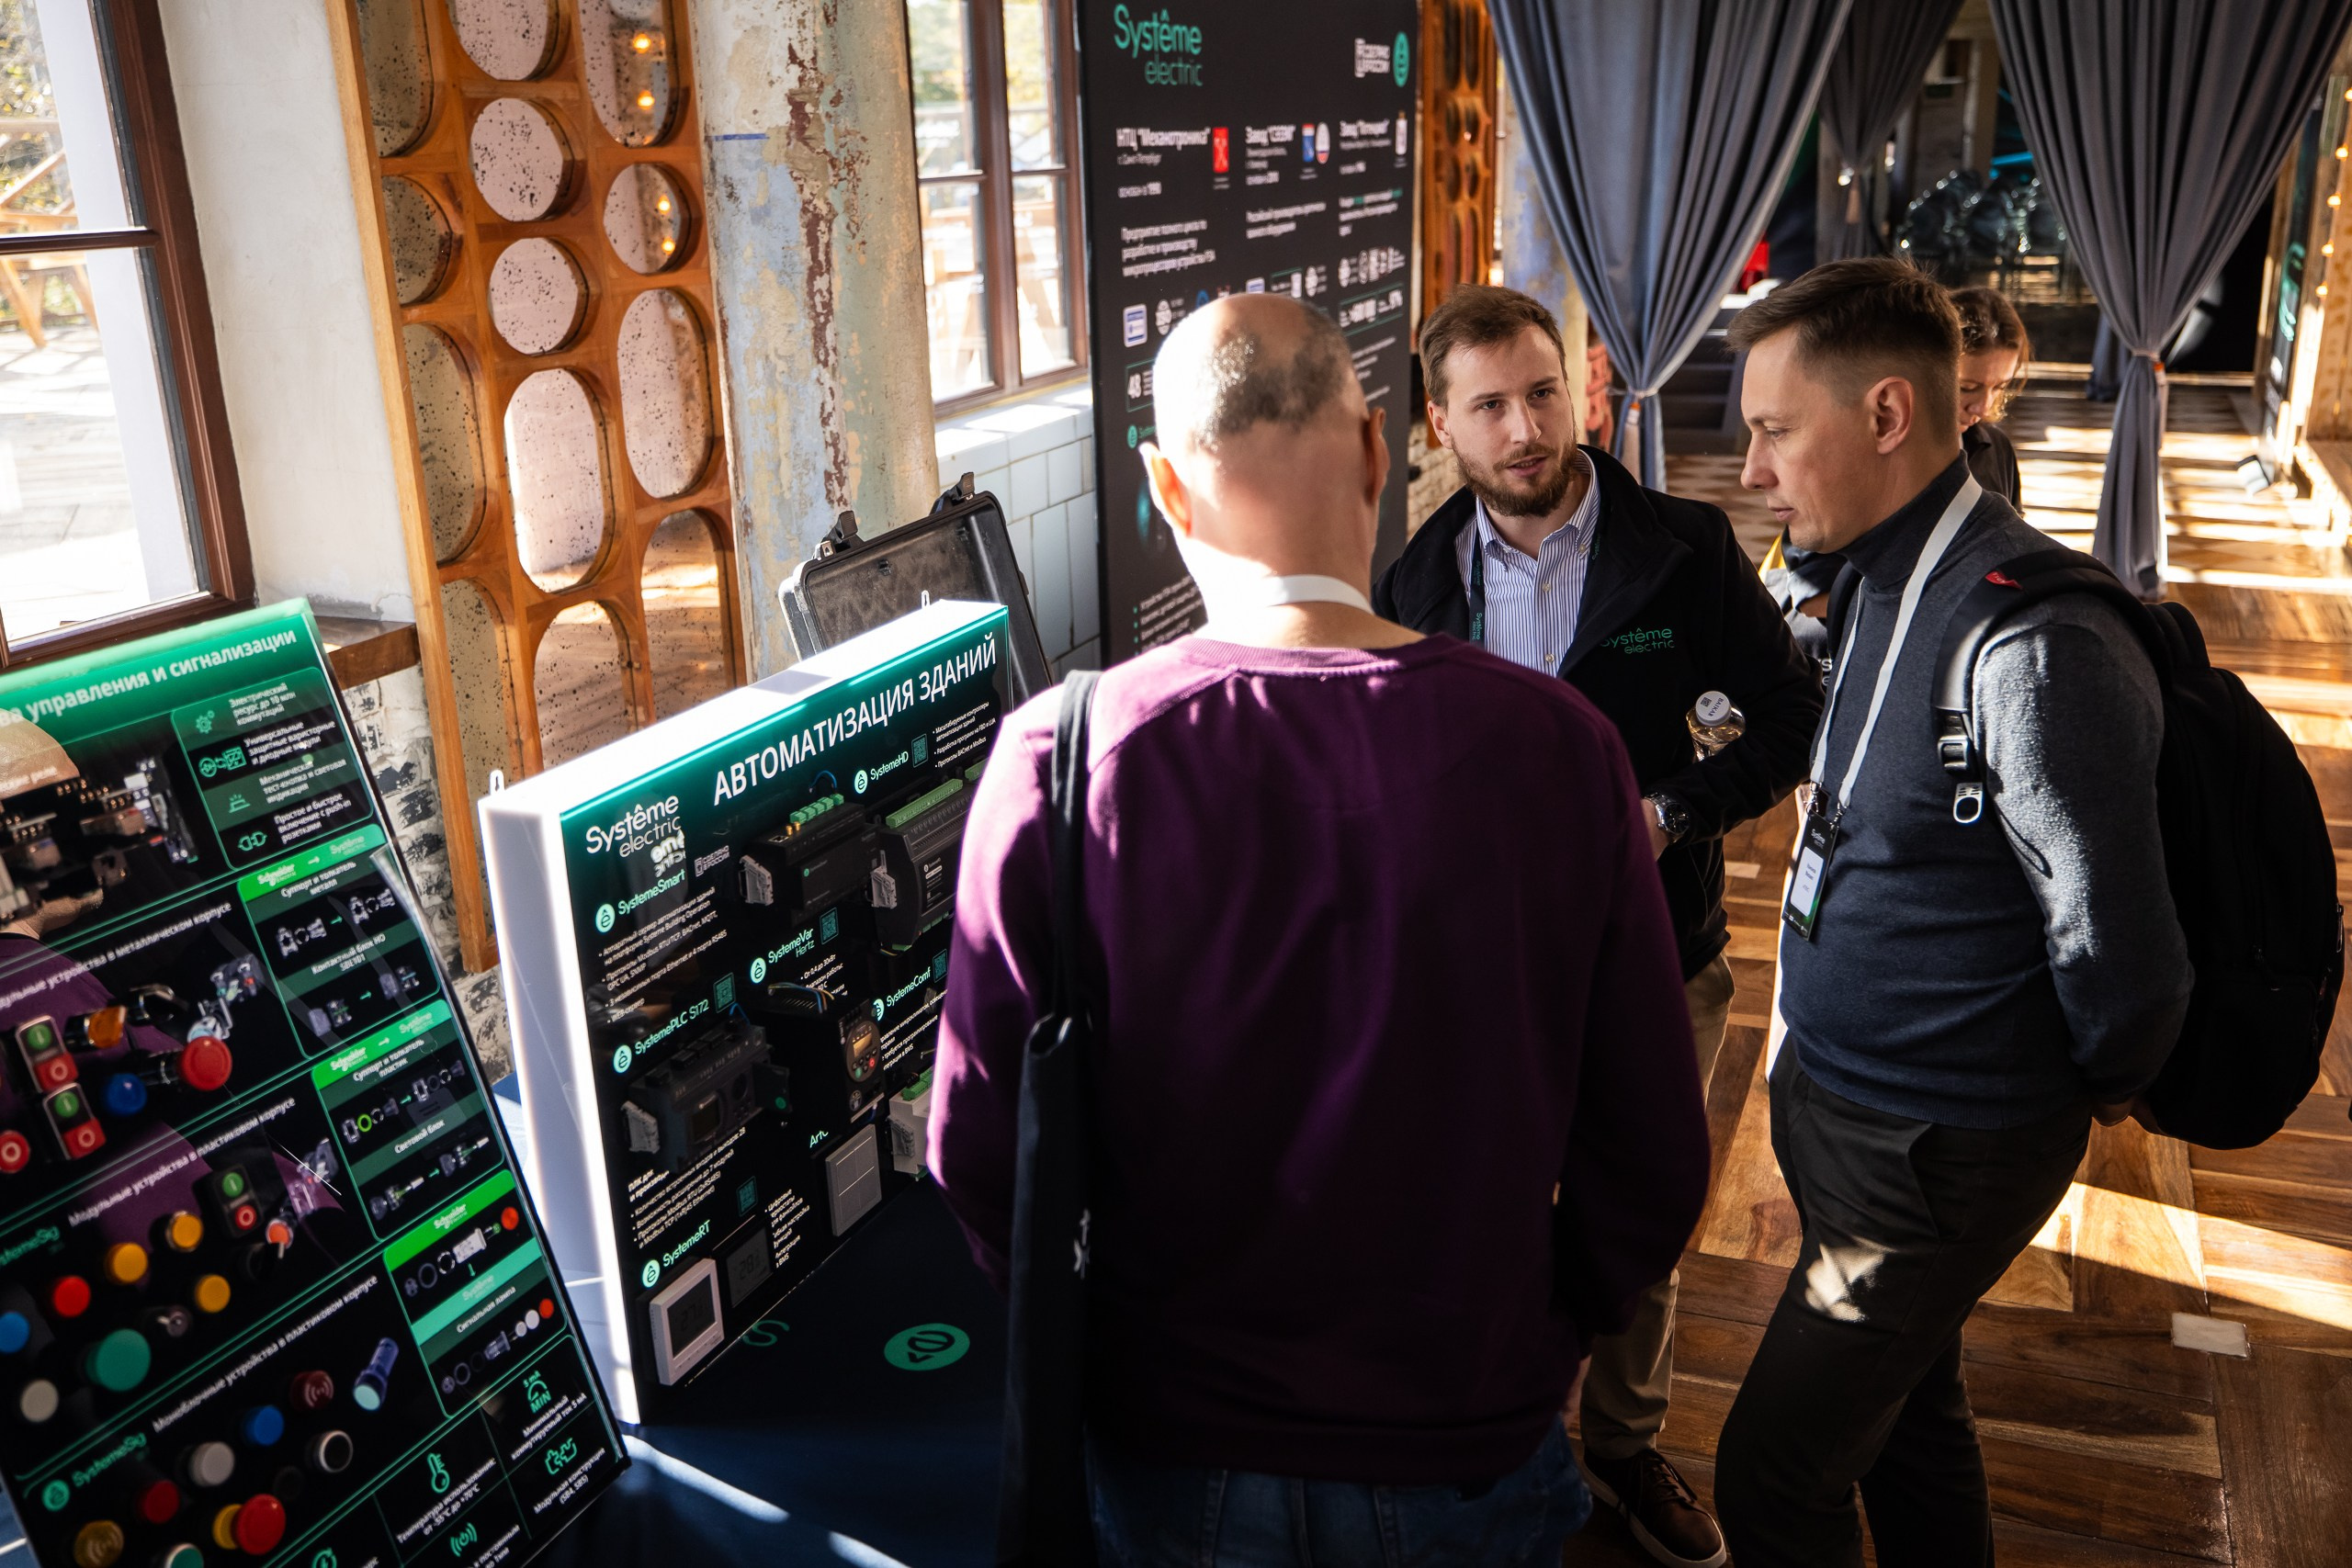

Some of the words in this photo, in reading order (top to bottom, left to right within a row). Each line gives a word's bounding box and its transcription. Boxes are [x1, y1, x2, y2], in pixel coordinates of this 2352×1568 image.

[1114, 4, 1203, 58] Systême
[1145, 58, 1203, 86] electric
[1624, 639, 1675, 654] electric
[27, 671, 149, 723] управления
[151, 666, 167, 682] и
[169, 630, 296, 676] сигнализации
[229, 682, 288, 708] Электрический
[232, 703, 259, 718] ресурс
[259, 699, 270, 710] до
[269, 694, 280, 704] 10
[278, 692, 296, 702] млн
[236, 703, 284, 726] коммутаций
[715, 680, 913, 803] АВТОМАТИЗАЦИЯ
[919, 632, 996, 701] ЗДАНИЙ
[935, 713, 967, 734] Масштабируемые
[967, 701, 989, 717] контроллеры
[935, 723, 962, 742] автоматизации
[962, 716, 975, 728] зданий
[243, 722, 303, 747] Универсальные
[248, 737, 288, 756] защитные
[287, 720, 335, 742] варисторные
[936, 739, 956, 754] Разработка
[956, 729, 974, 743] программ
[258, 745, 292, 764] диодные
[870, 750, 909, 780] SystemeHD
[937, 752, 957, 768] Протоколы
[957, 745, 969, 756] BACnet
[972, 736, 986, 748] Modbus
[259, 760, 313, 785] Механическая
[263, 773, 308, 795] тест-кнопка
[313, 759, 346, 776] световая
[266, 783, 309, 804] индикация
[273, 807, 306, 824] Простое
[311, 793, 343, 809] быстрое
[277, 811, 320, 833] включение
[324, 799, 351, 817] push-in
[281, 821, 322, 843] розетками
[586, 795, 678, 852] Systême
[619, 816, 681, 857] electric
[703, 845, 729, 863] СДЕЛАНО
[707, 851, 729, 867] РОССИИ
[280, 878, 312, 897] Суппорт
[319, 862, 356, 880] толкатель
[310, 878, 337, 895] металл
[618, 869, 684, 914] SystemeSmart
[603, 931, 637, 956] Аппаратный
[638, 920, 657, 936] сервер
[657, 898, 696, 925] автоматизации
[696, 886, 715, 903] зданий
[604, 956, 611, 965] на
[611, 939, 643, 961] платформе
[643, 926, 664, 943] Systeme
[664, 914, 685, 931] Building
[685, 899, 710, 919] Operation
[47, 954, 107, 988] устройства
[107, 951, 116, 961] в
[115, 919, 193, 956] металлическом
[193, 902, 232, 924] корпусе
[311, 947, 356, 974] Контактный
[355, 940, 374, 953] блок
[768, 928, 813, 964] SystemeVar
[796, 940, 814, 957] Hertz
[605, 959, 637, 981] Протоколы
[637, 945, 659, 962] Modbus
[614, 977, 650, 1004] независимых
[650, 966, 666, 981] порта
[666, 953, 688, 972] Ethernet
[696, 939, 711, 953] порта
[803, 971, 809, 979] От
[817, 963, 823, 972] до
[886, 966, 931, 1007] SystemeComf
[635, 1010, 687, 1054] SystemePLC
[688, 998, 709, 1020] S172
[884, 1041, 902, 1059] требуется
[902, 1014, 937, 1044] программирование
[352, 1060, 383, 1081] Суппорт
[389, 1039, 424, 1061] толкатель
[904, 1043, 913, 1055] BMS
[379, 1057, 408, 1077] пластик
[394, 1128, 428, 1153] Световой
[426, 1120, 445, 1134] блок
[69, 1186, 132, 1224] Модульные
[132, 1156, 188, 1194] устройства
[197, 1117, 259, 1156] пластиковом
[258, 1098, 295, 1122] корпусе
[628, 1177, 641, 1192] ПЛК
[635, 1190, 665, 1216] Количество
[665, 1167, 695, 1192] встроенных
[695, 1152, 713, 1170] входов
[636, 1200, 671, 1229] Возможность
[671, 1174, 703, 1203] расширения
[703, 1168, 709, 1179] до
[713, 1148, 734, 1168] модулей
[767, 1189, 792, 1212] Цифровые
[638, 1213, 667, 1240] Протоколы
[667, 1197, 687, 1216] Modbus
[686, 1189, 697, 1201] RTU
[778, 1197, 803, 1222] фанкойлов
[786, 1204, 810, 1226] настройка
[643, 1224, 664, 1245] Modbus
[662, 1219, 709, 1267] SystemeRT
[778, 1252, 789, 1266] BMS
[456, 1301, 495, 1333] Сигнальная
[494, 1286, 516, 1305] лампа
[153, 1379, 225, 1431] Моноблочные
[225, 1343, 278, 1385] устройства
[285, 1299, 344, 1342] пластиковом
[343, 1275, 378, 1303] корпусе
[522, 1395, 569, 1437] Минимальный
[530, 1390, 551, 1413] MIN
[511, 1413, 562, 1460] коммутируемый
[561, 1404, 572, 1417] ток
[533, 1480, 569, 1513] Модульная
[568, 1448, 605, 1483] конструкция
[397, 1502, 444, 1543] Температура
[443, 1458, 495, 1505] использования:
[423, 1524, 433, 1535] от
[450, 1500, 461, 1514] до
